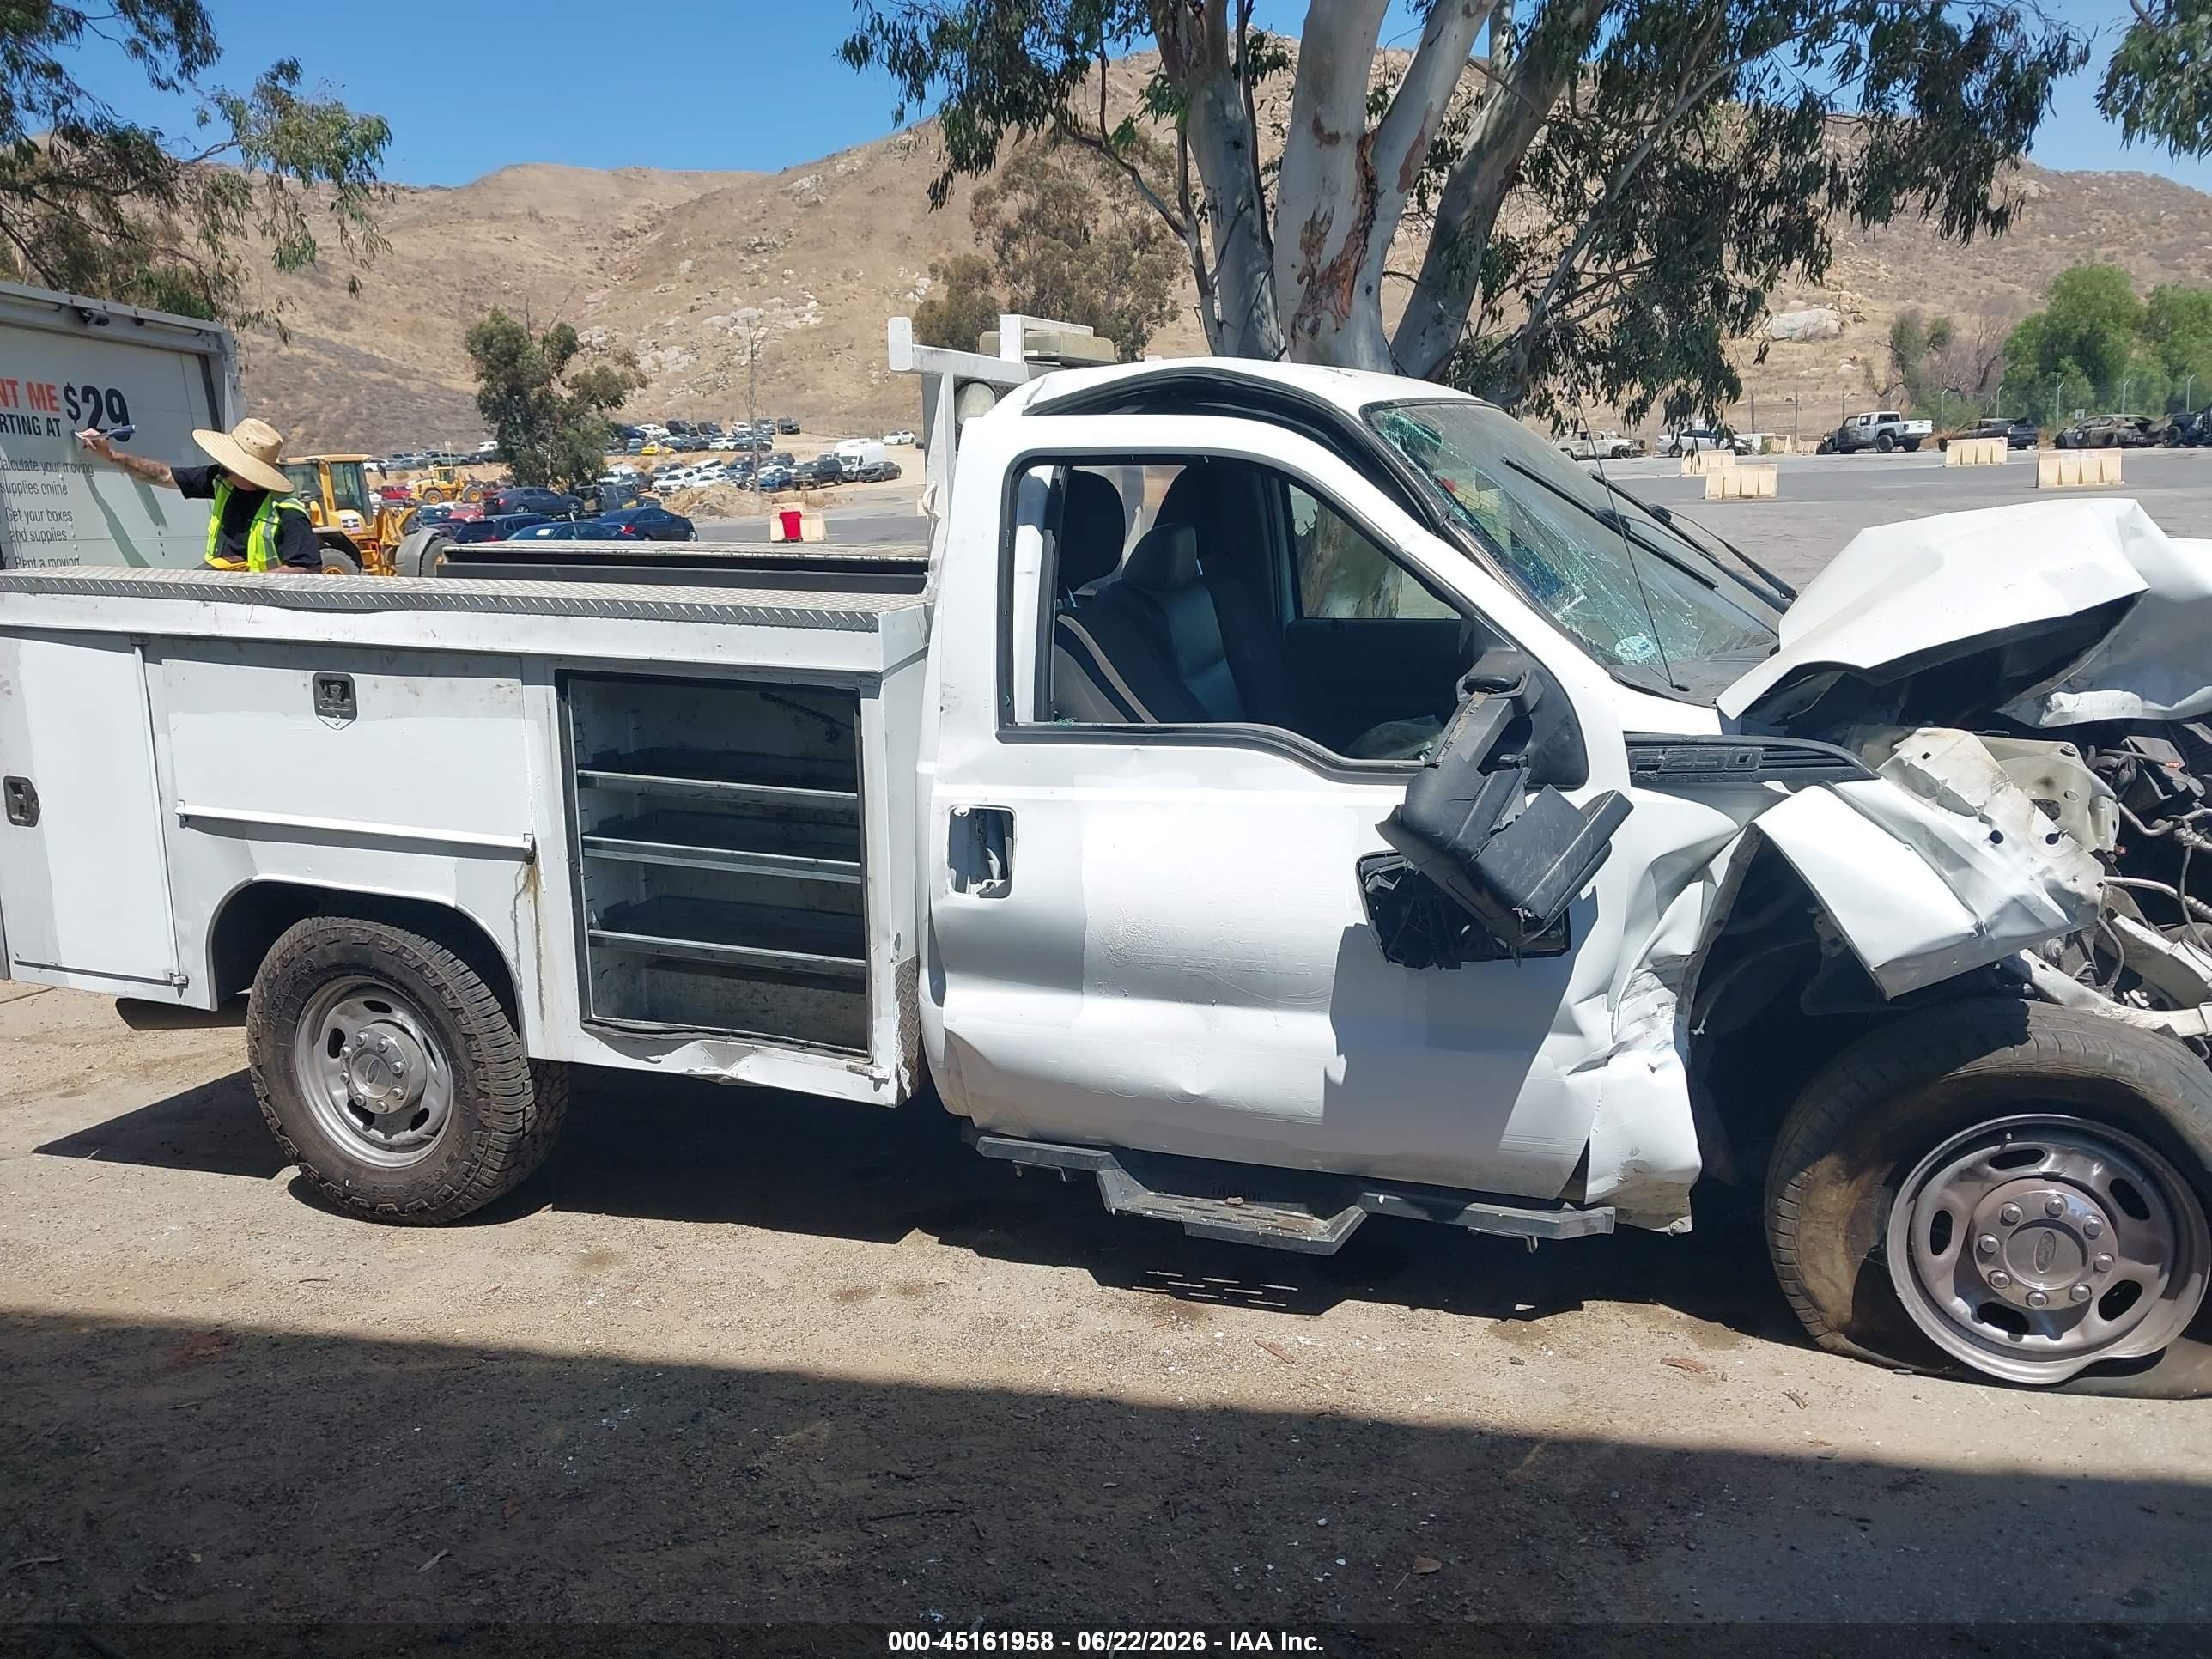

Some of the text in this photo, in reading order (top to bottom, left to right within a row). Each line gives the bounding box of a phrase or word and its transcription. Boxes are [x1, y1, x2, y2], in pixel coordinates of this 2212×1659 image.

[27, 380, 60, 412] ME
[64, 382, 131, 442] $29
[46, 417, 61, 437] AT
[0, 455, 94, 477] alculate your moving
[0, 479, 68, 497] supplies online
[6, 507, 73, 525] Get your boxes
[9, 527, 68, 544] and supplies
[15, 556, 36, 568] Rent
[39, 558, 46, 568] a
